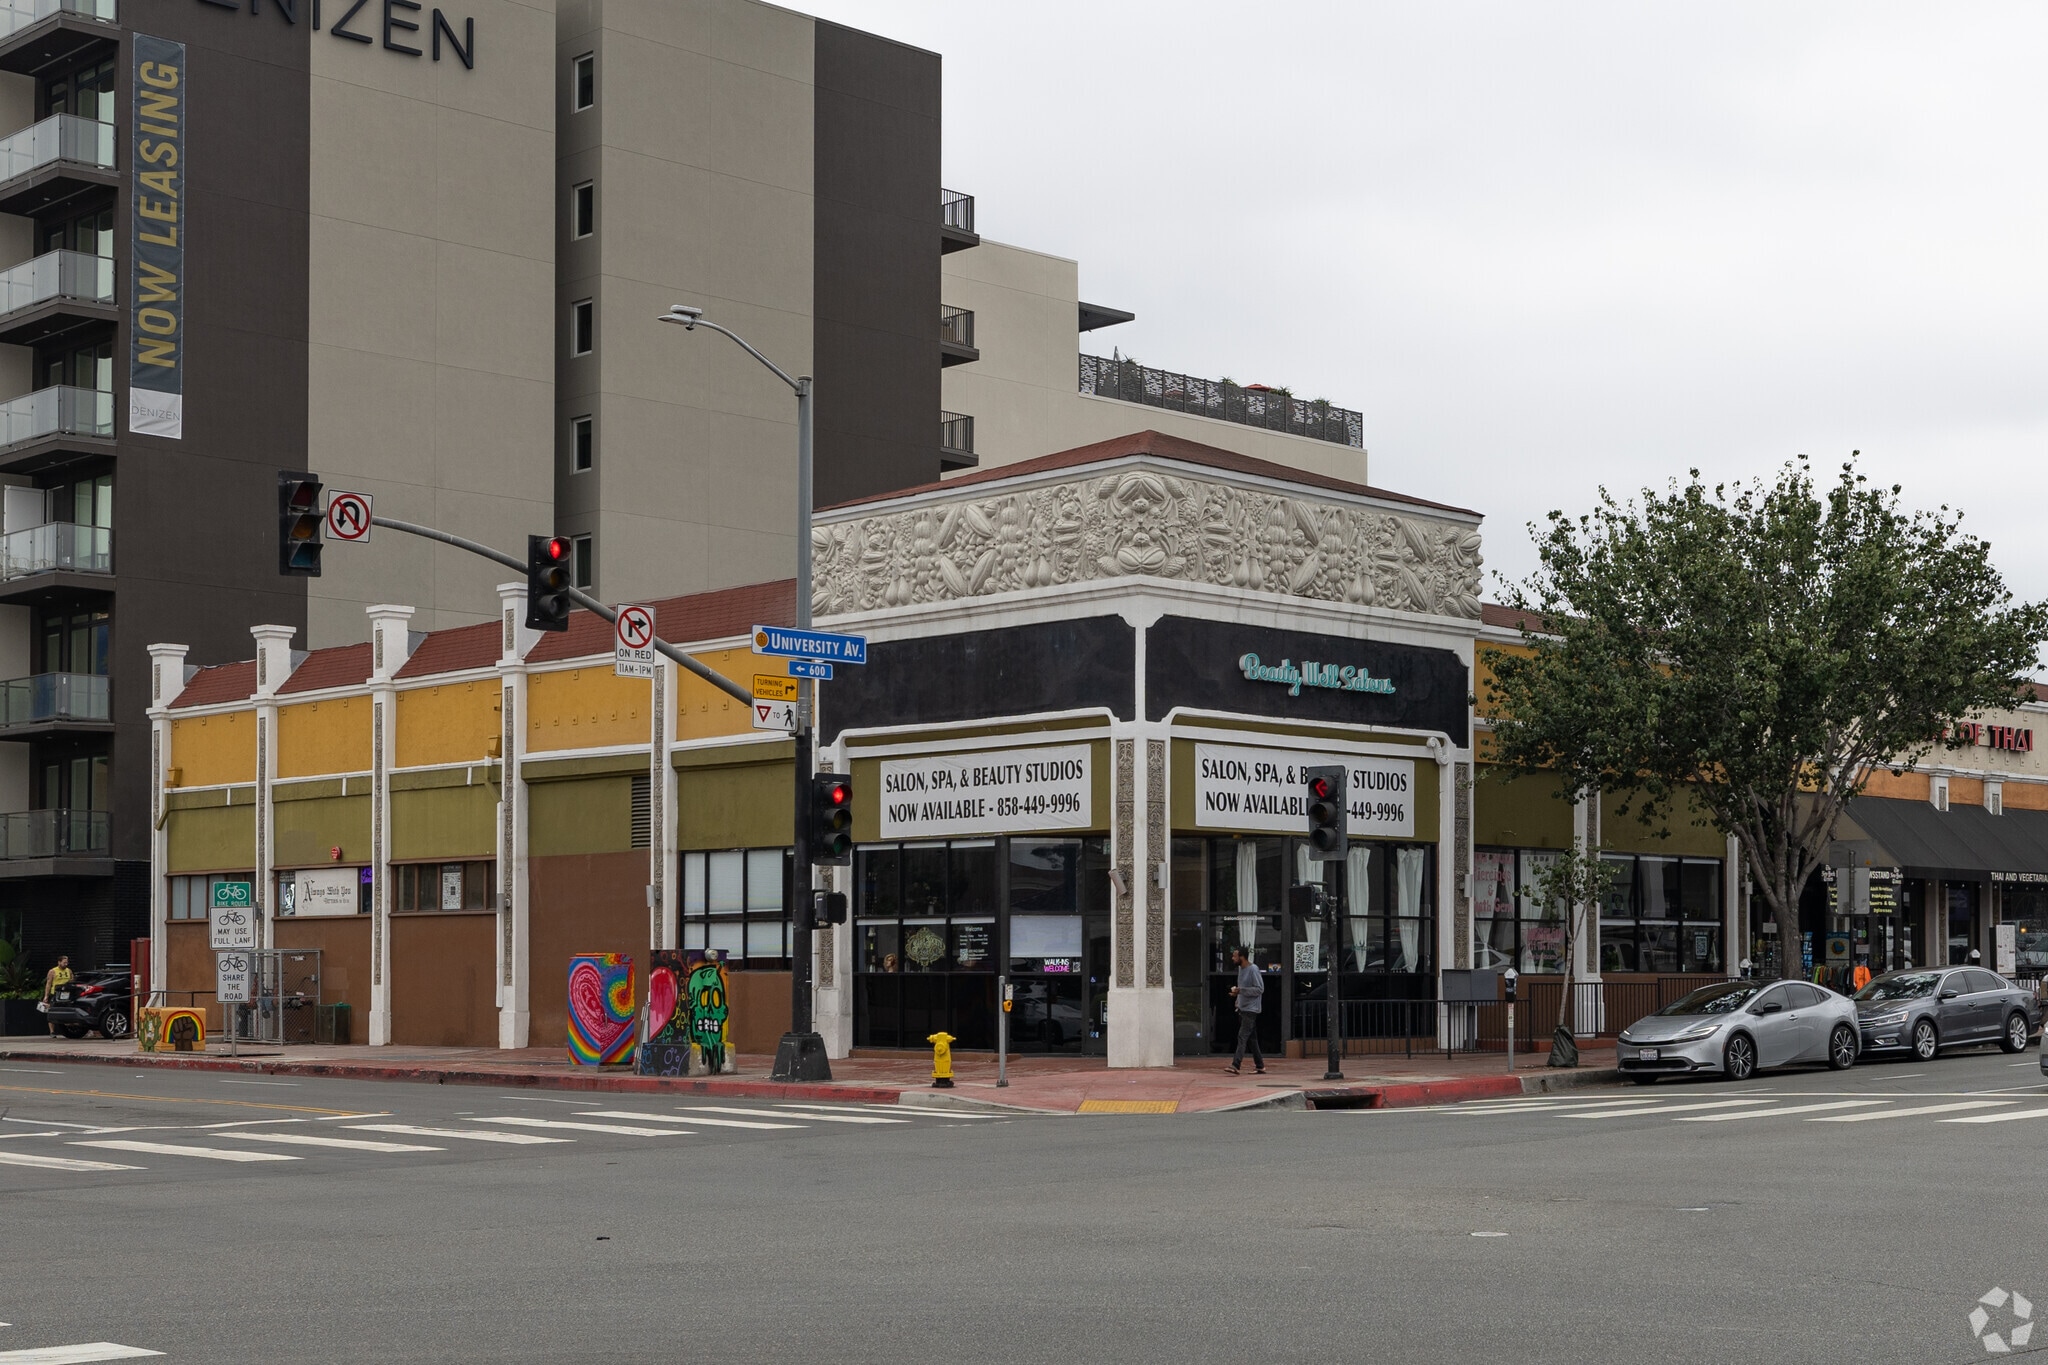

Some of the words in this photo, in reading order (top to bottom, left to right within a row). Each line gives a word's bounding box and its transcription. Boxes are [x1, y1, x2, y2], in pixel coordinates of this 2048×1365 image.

[138, 61, 179, 248] LEASING
[137, 260, 178, 368] NOW
[131, 405, 180, 421] DENIZEN
[619, 648, 631, 658] ON
[635, 650, 652, 660] RED
[757, 678, 783, 687] TURNING
[809, 665, 826, 677] 600
[1239, 652, 1302, 697] Beauty
[1302, 661, 1342, 689] Well
[1340, 665, 1397, 695] Salons
[756, 688, 784, 697] VEHICLES
[1992, 725, 2033, 752] THAI
[886, 771, 929, 794] SALON,
[932, 770, 957, 792] SPA,
[960, 768, 970, 788] &
[973, 764, 1022, 787] BEAUTY
[1025, 759, 1083, 783] STUDIOS
[1202, 758, 1251, 785] SALON,
[1255, 762, 1283, 787] SPA,
[1286, 766, 1296, 785] &
[1353, 769, 1407, 792] STUDIOS
[889, 803, 919, 823] NOW
[921, 798, 985, 821] AVAILABLE
[997, 792, 1080, 816] 858-449-9996
[1205, 791, 1240, 813] NOW
[1347, 800, 1404, 822] -449-9996
[1991, 872, 2004, 881] THAI
[2005, 873, 2017, 881] AND
[223, 974, 244, 982] SHARE
